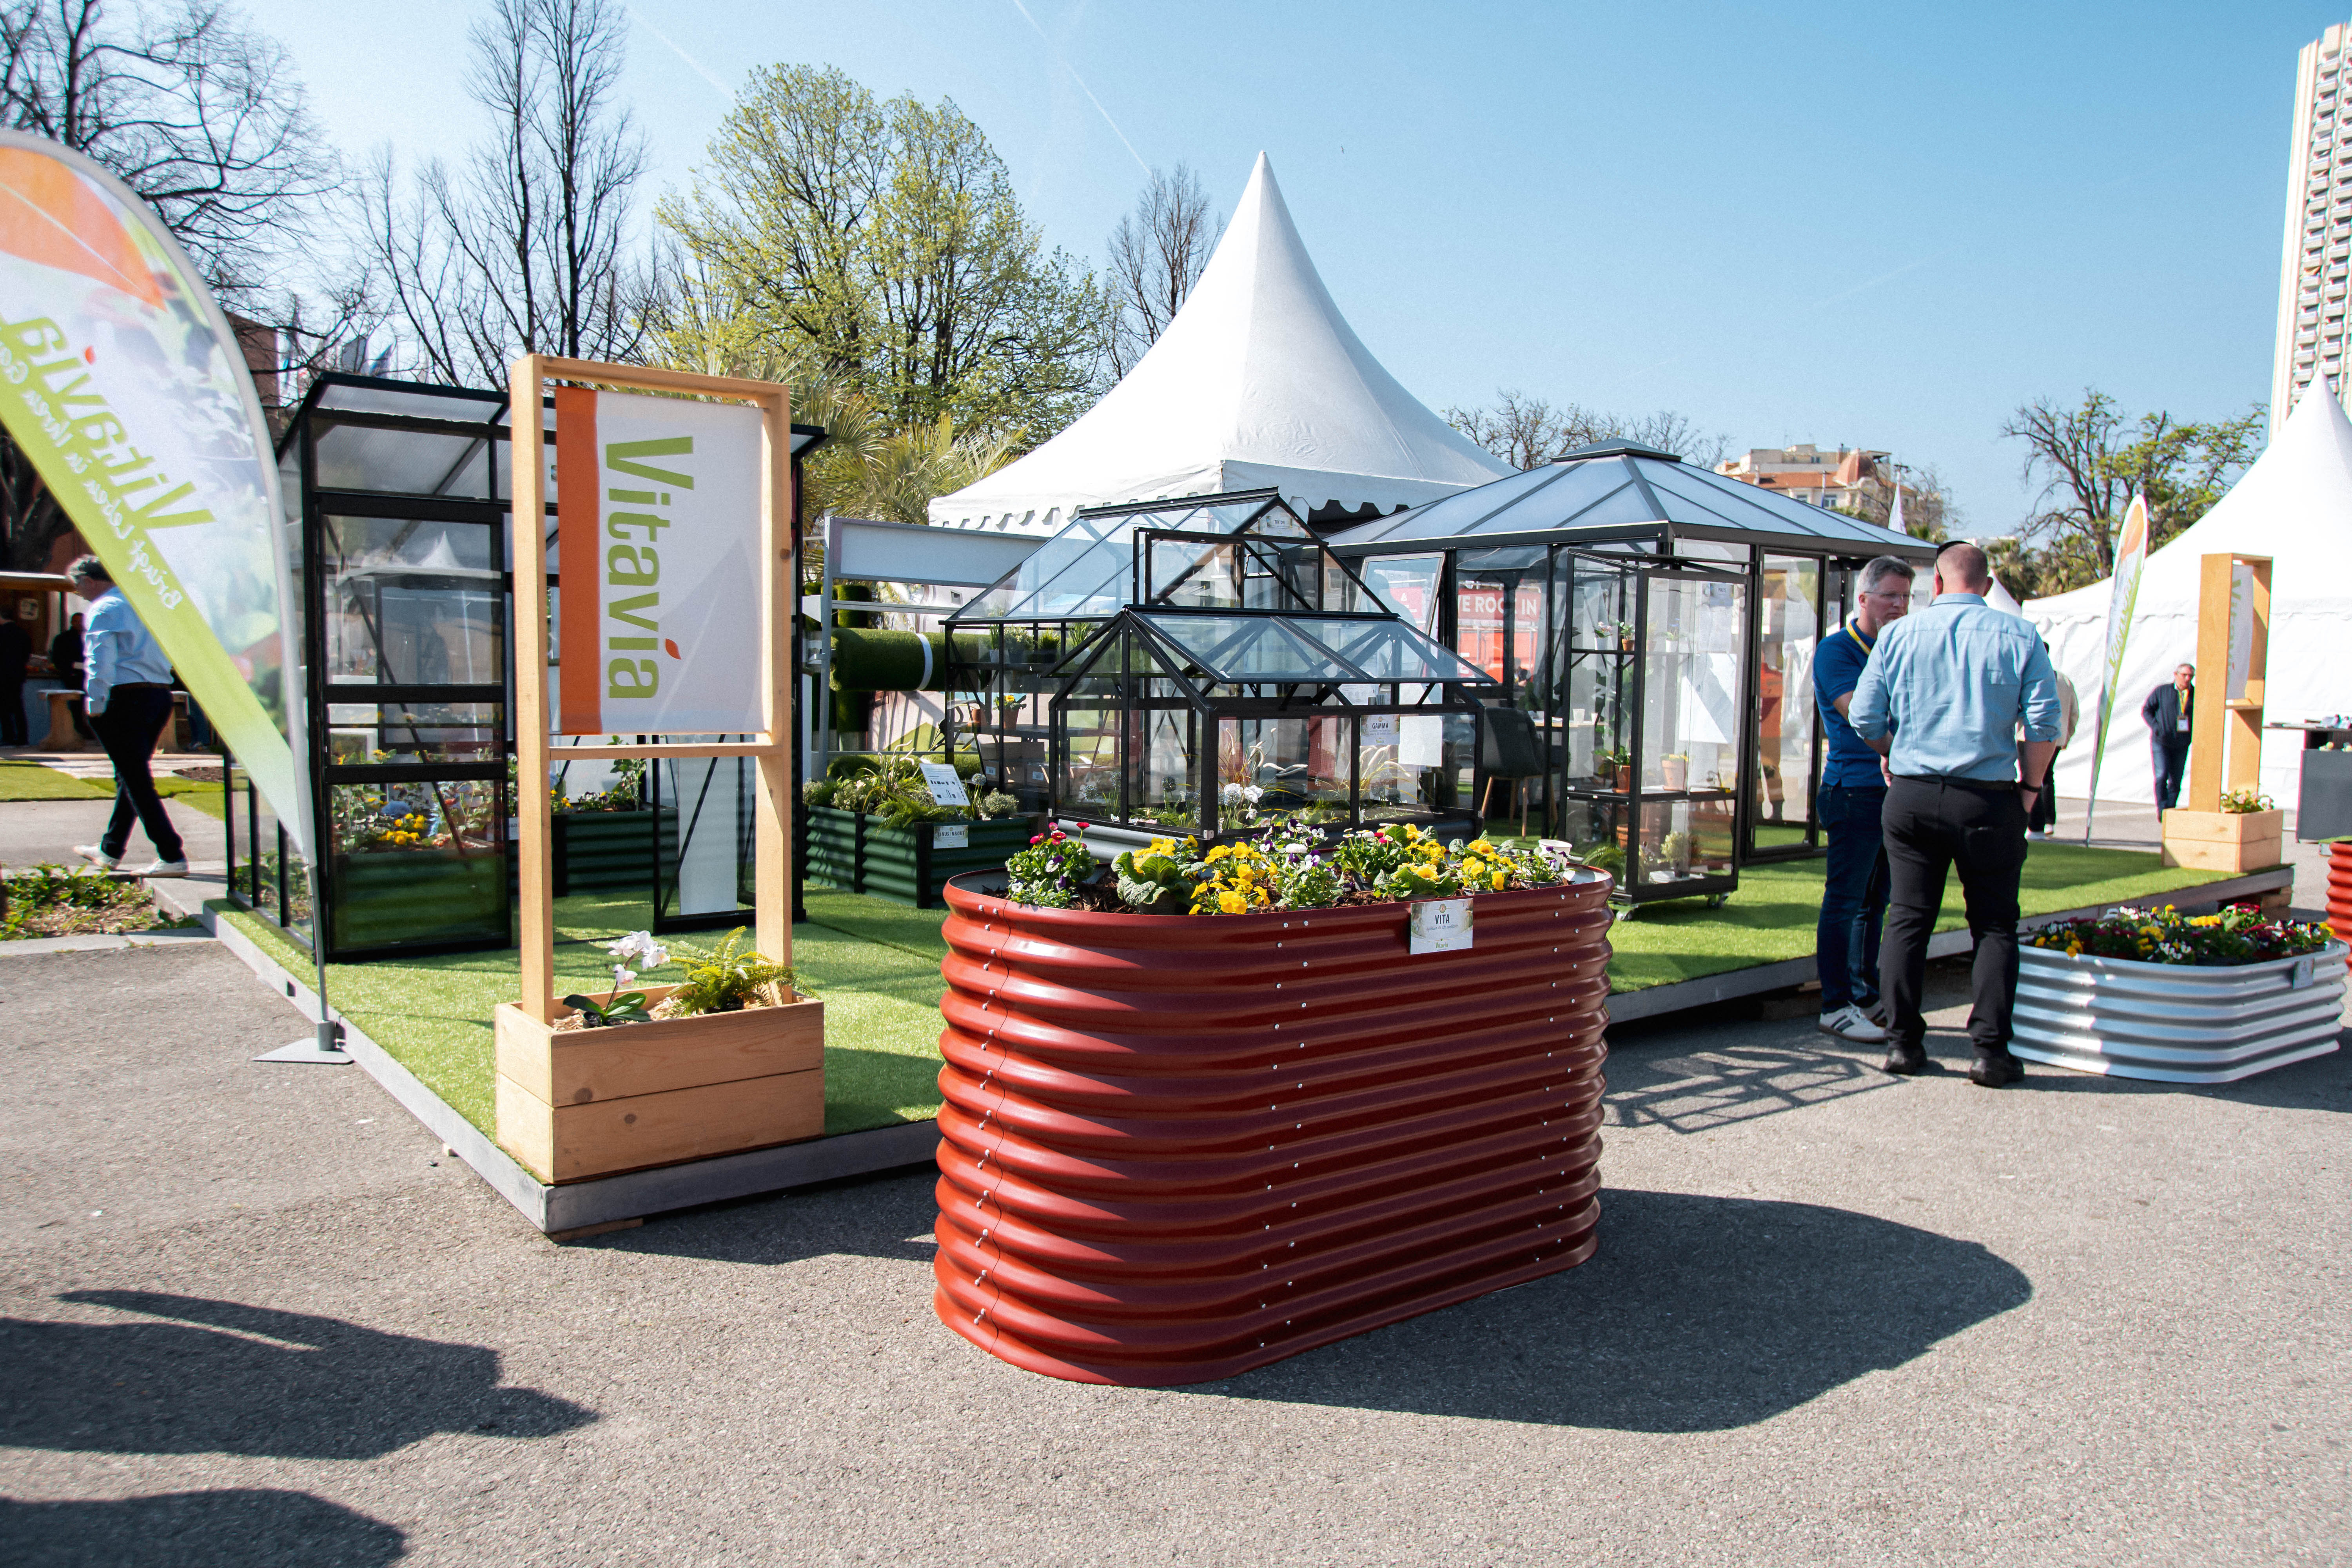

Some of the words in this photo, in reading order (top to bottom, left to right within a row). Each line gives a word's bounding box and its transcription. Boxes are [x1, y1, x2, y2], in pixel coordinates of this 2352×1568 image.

[606, 436, 695, 699] Vitavia
[1475, 596, 1517, 614] ROC
[1521, 599, 1537, 615] IN
[1435, 914, 1450, 924] VITA
